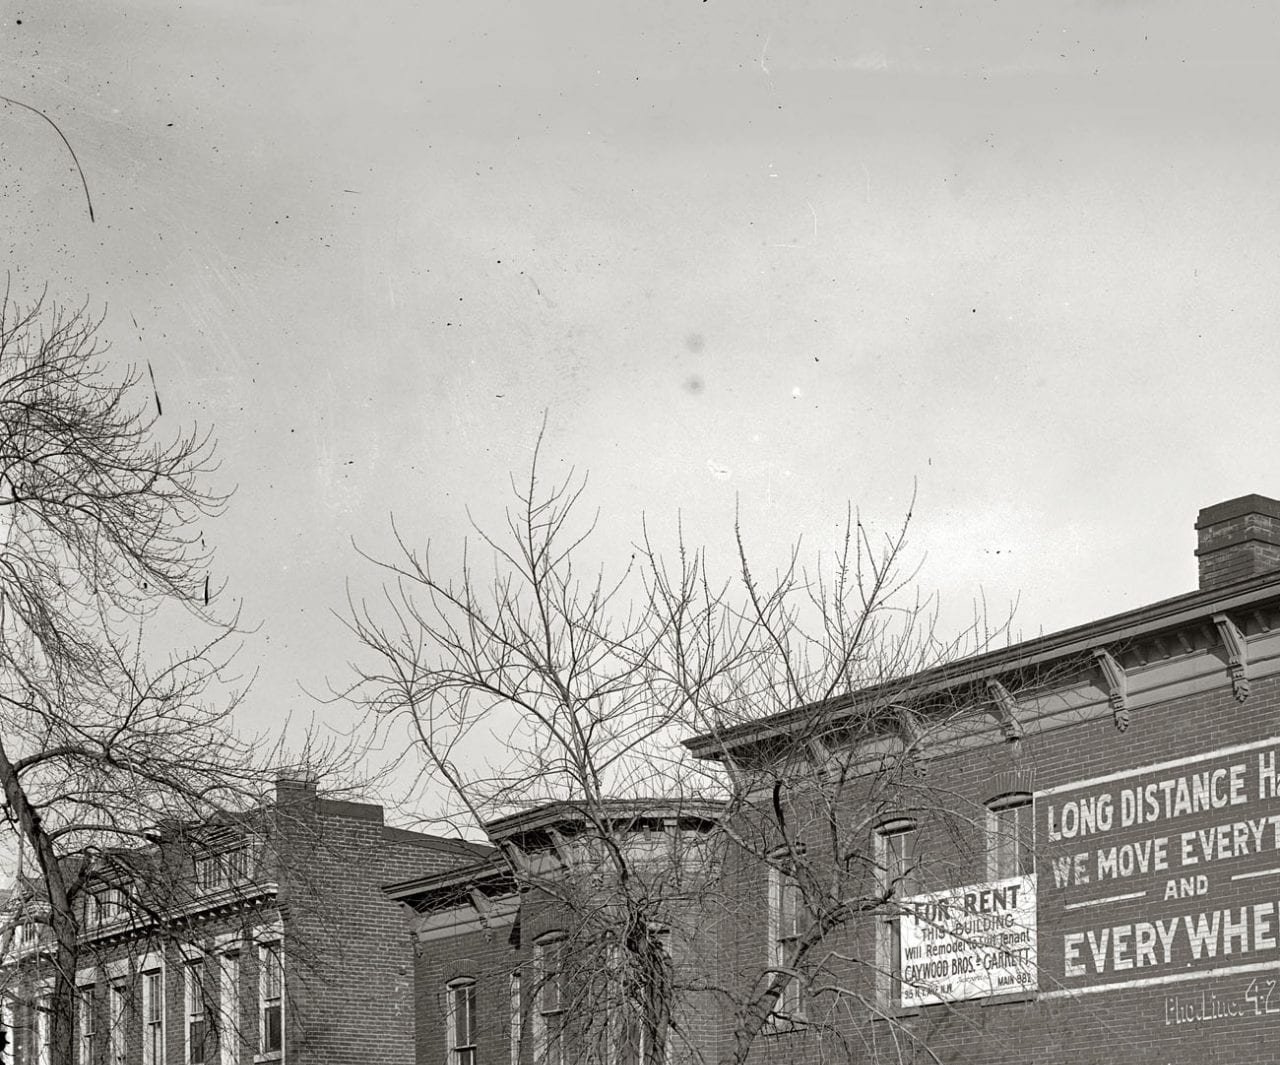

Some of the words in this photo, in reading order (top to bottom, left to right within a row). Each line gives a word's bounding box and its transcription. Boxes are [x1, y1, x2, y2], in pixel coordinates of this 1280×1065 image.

[1048, 793, 1114, 842] LONG
[1121, 764, 1248, 828] DISTANCE
[1052, 852, 1090, 889] WE
[1097, 837, 1169, 881] MOVE
[1164, 875, 1209, 901] AND
[914, 899, 951, 926] FOR
[964, 884, 1021, 917] RENT
[921, 925, 945, 941] THIS
[956, 913, 1014, 936] BUILDING
[904, 945, 921, 960] Will
[926, 939, 965, 957] Remodel
[904, 959, 949, 982] CAYWOOD
[951, 956, 976, 975] BROS.
[984, 947, 1031, 971] GARRETT
[998, 975, 1015, 987] MAIN
